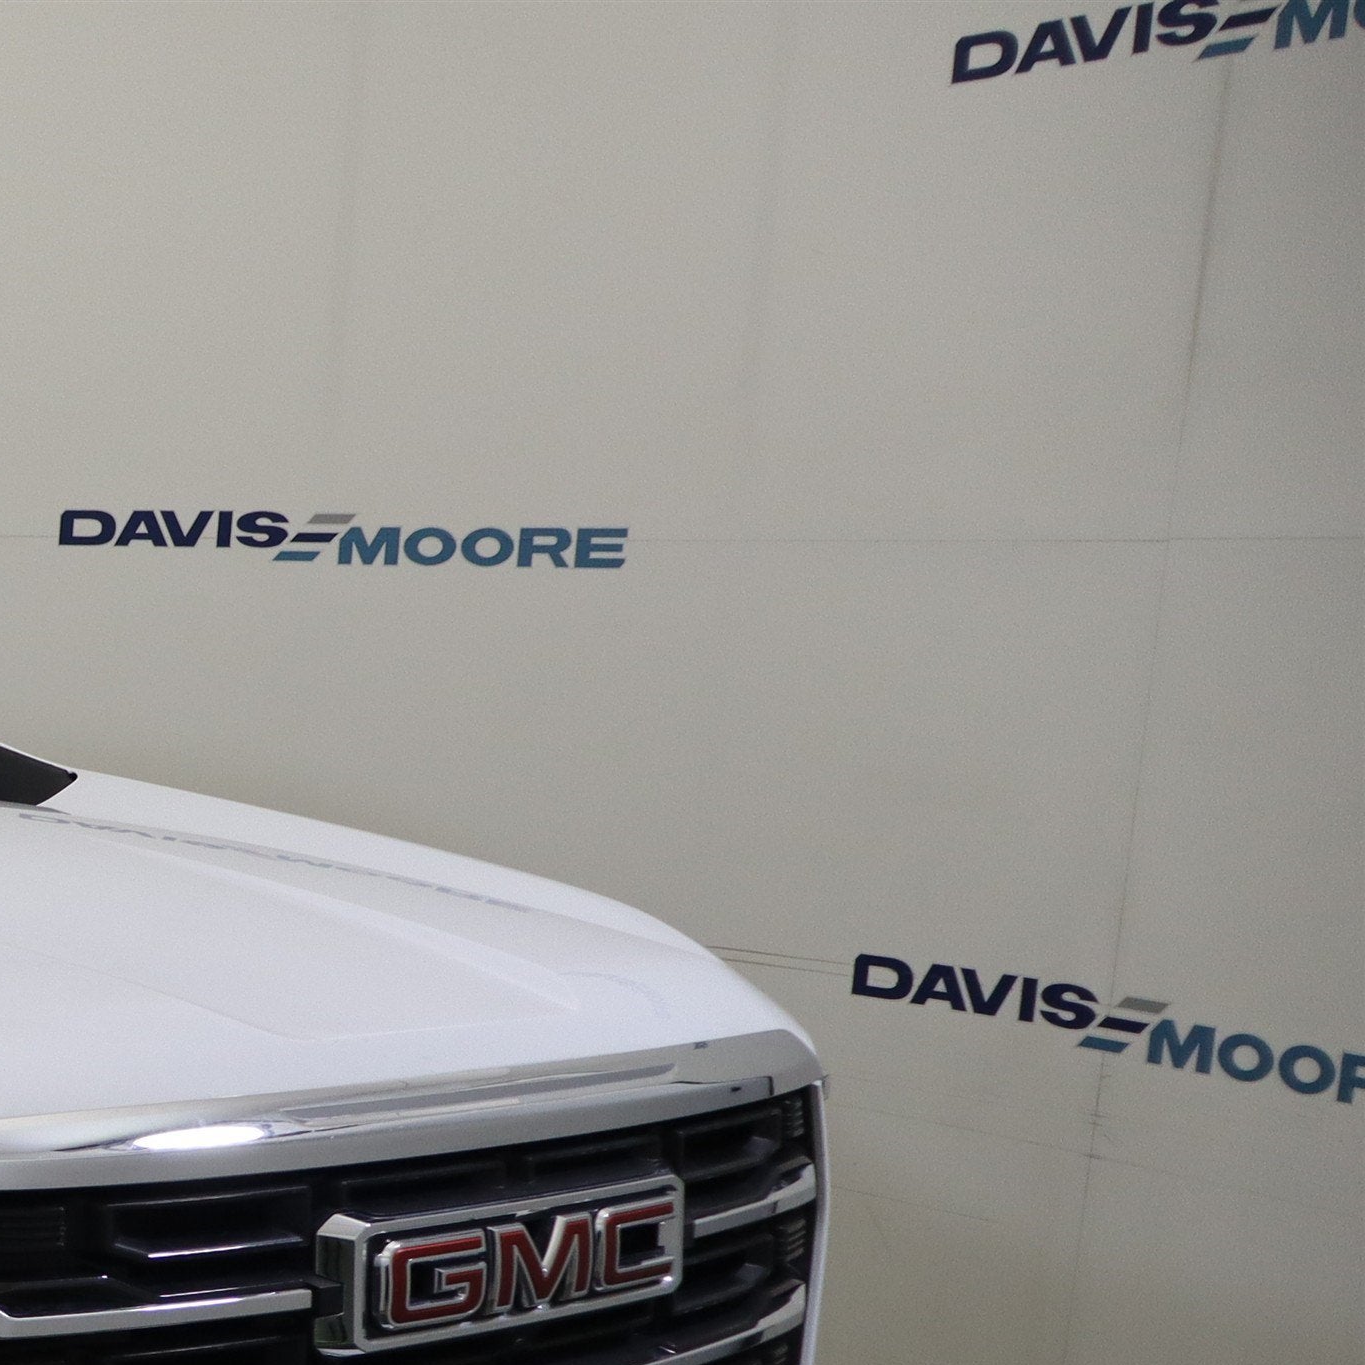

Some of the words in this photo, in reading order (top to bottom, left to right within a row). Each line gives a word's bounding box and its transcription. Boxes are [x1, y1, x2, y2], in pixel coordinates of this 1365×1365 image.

[951, 0, 1219, 84] DAVIS
[58, 509, 290, 548] DAVIS
[338, 525, 629, 569] MOORE
[851, 953, 1098, 1030] DAVIS
[378, 1195, 677, 1330] GMC
